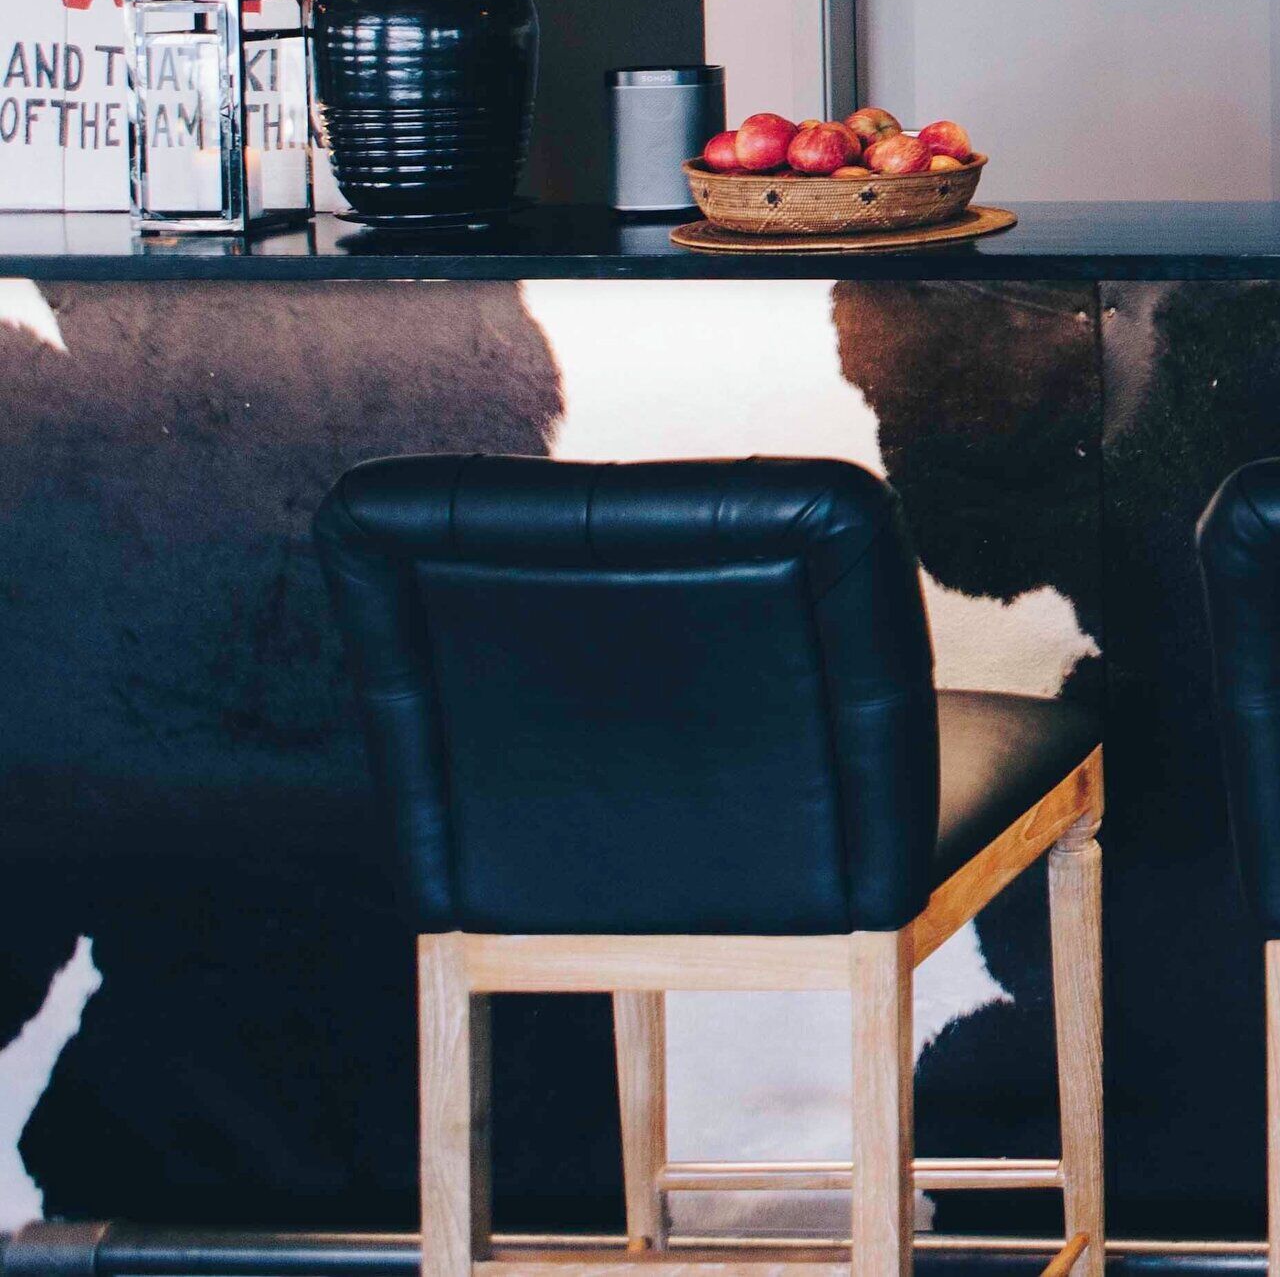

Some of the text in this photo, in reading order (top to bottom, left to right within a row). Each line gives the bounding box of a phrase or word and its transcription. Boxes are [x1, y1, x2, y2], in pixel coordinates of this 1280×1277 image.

[3, 41, 84, 92] AND
[641, 75, 673, 83] SONOS
[0, 96, 46, 146] OF
[50, 98, 122, 151] THE
